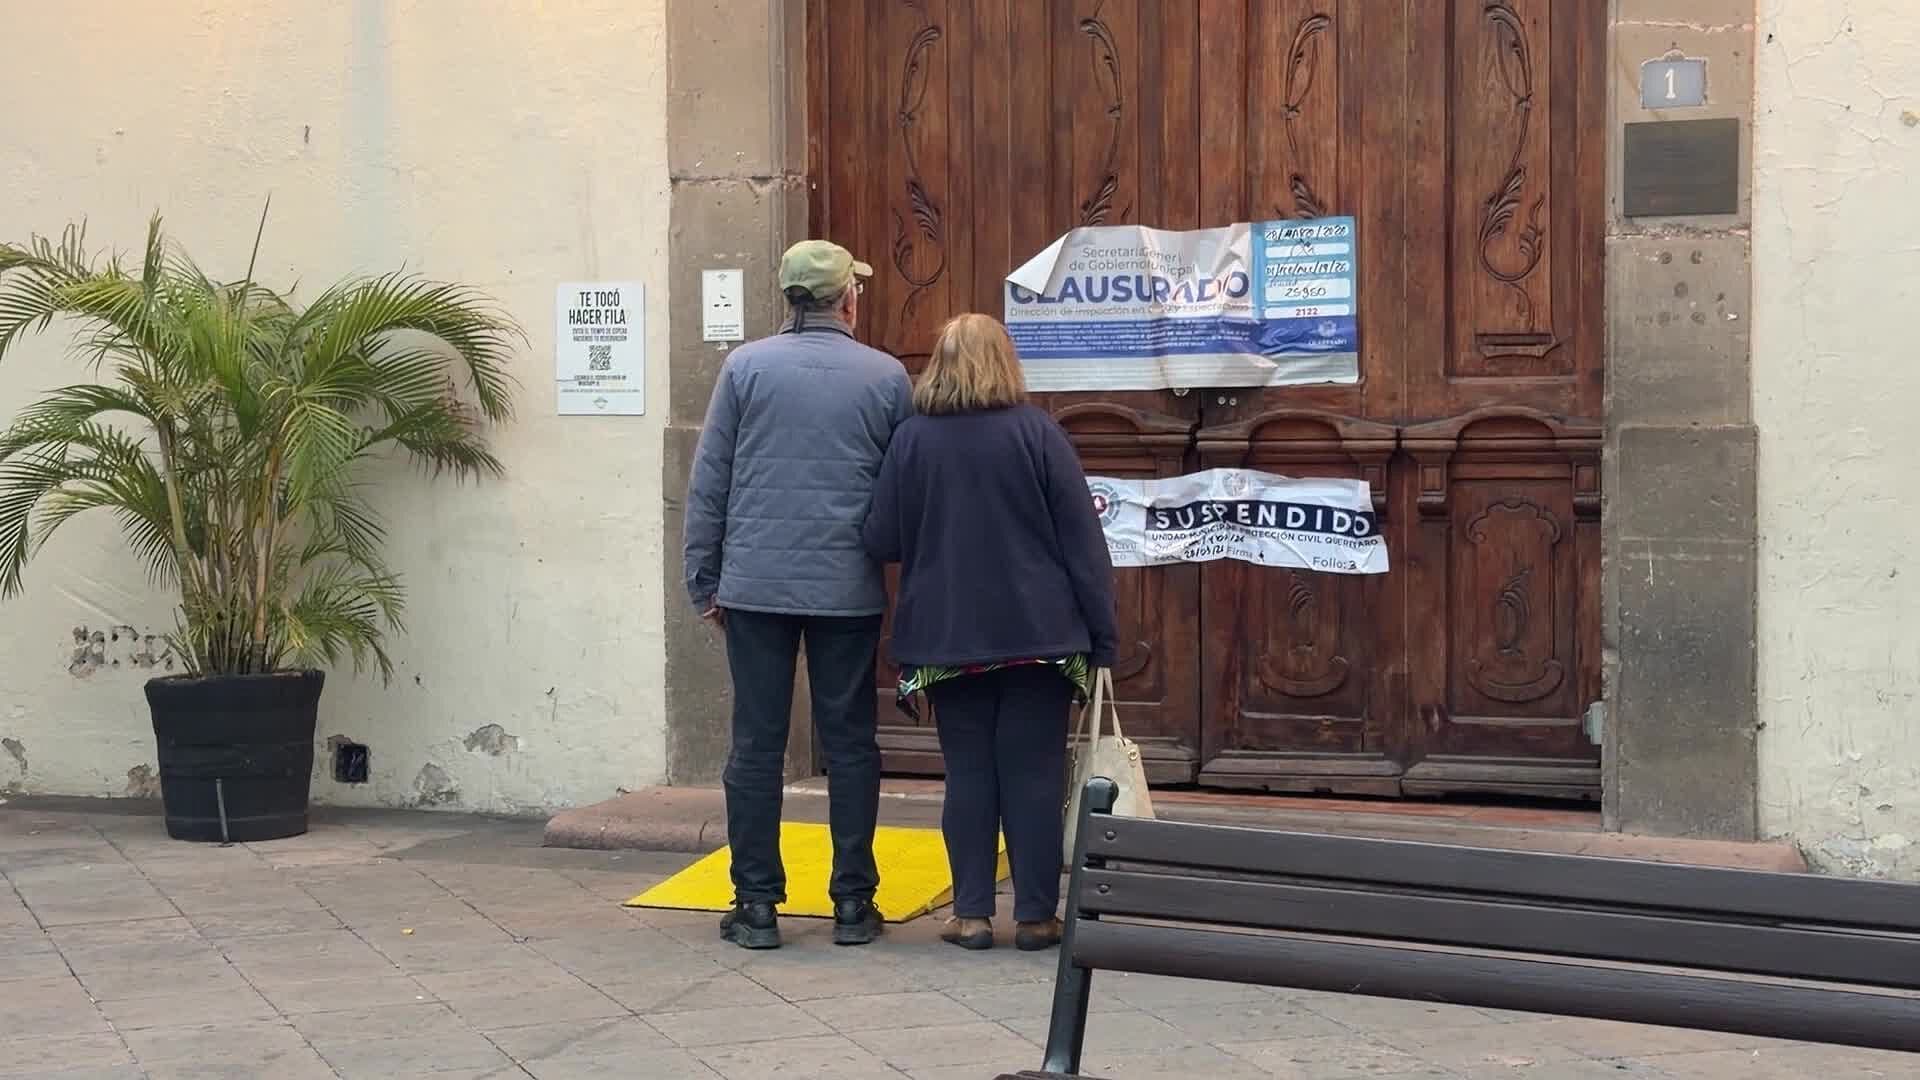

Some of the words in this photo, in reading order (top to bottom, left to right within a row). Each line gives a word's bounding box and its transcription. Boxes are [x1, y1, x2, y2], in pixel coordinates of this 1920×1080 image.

[1664, 68, 1676, 99] 1
[1069, 260, 1085, 271] de
[579, 291, 592, 307] TE
[594, 287, 620, 307] TOCÓ
[568, 308, 602, 325] HACER
[604, 308, 626, 325] FILA
[1295, 307, 1318, 316] 2122
[1155, 503, 1370, 537] SUSPENDIDO
[1152, 533, 1186, 541] UNIDAD
[1297, 534, 1322, 544] CIVIL
[1312, 556, 1346, 569] Folio:
